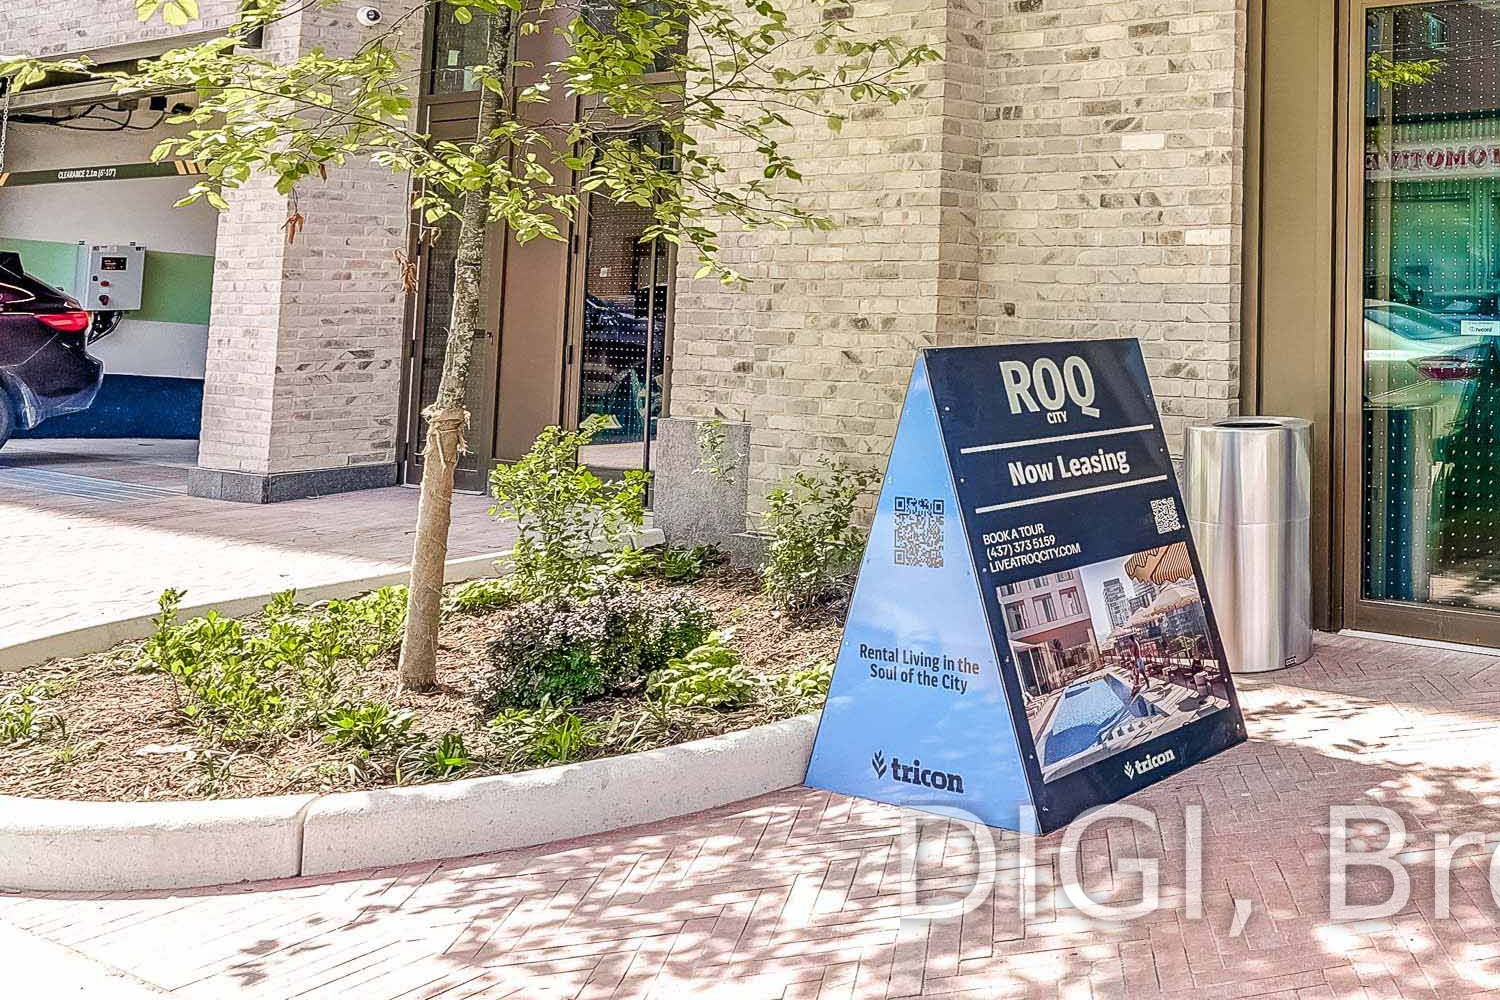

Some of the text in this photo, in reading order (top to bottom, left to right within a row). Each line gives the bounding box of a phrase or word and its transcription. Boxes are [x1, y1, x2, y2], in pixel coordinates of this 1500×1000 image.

[999, 355, 1100, 418] ROQ
[1046, 410, 1068, 424] CITY
[1008, 448, 1131, 487] Now Leasing
[983, 523, 1046, 545] BOOK A TOUR
[987, 534, 1056, 560] (437) 373 5159
[989, 542, 1082, 573] LIVEATROQCITY.COM
[859, 643, 980, 675] Rental Living in the
[870, 663, 968, 695] Soul of the City
[891, 757, 964, 794] tricon
[1134, 749, 1176, 775] tricon
